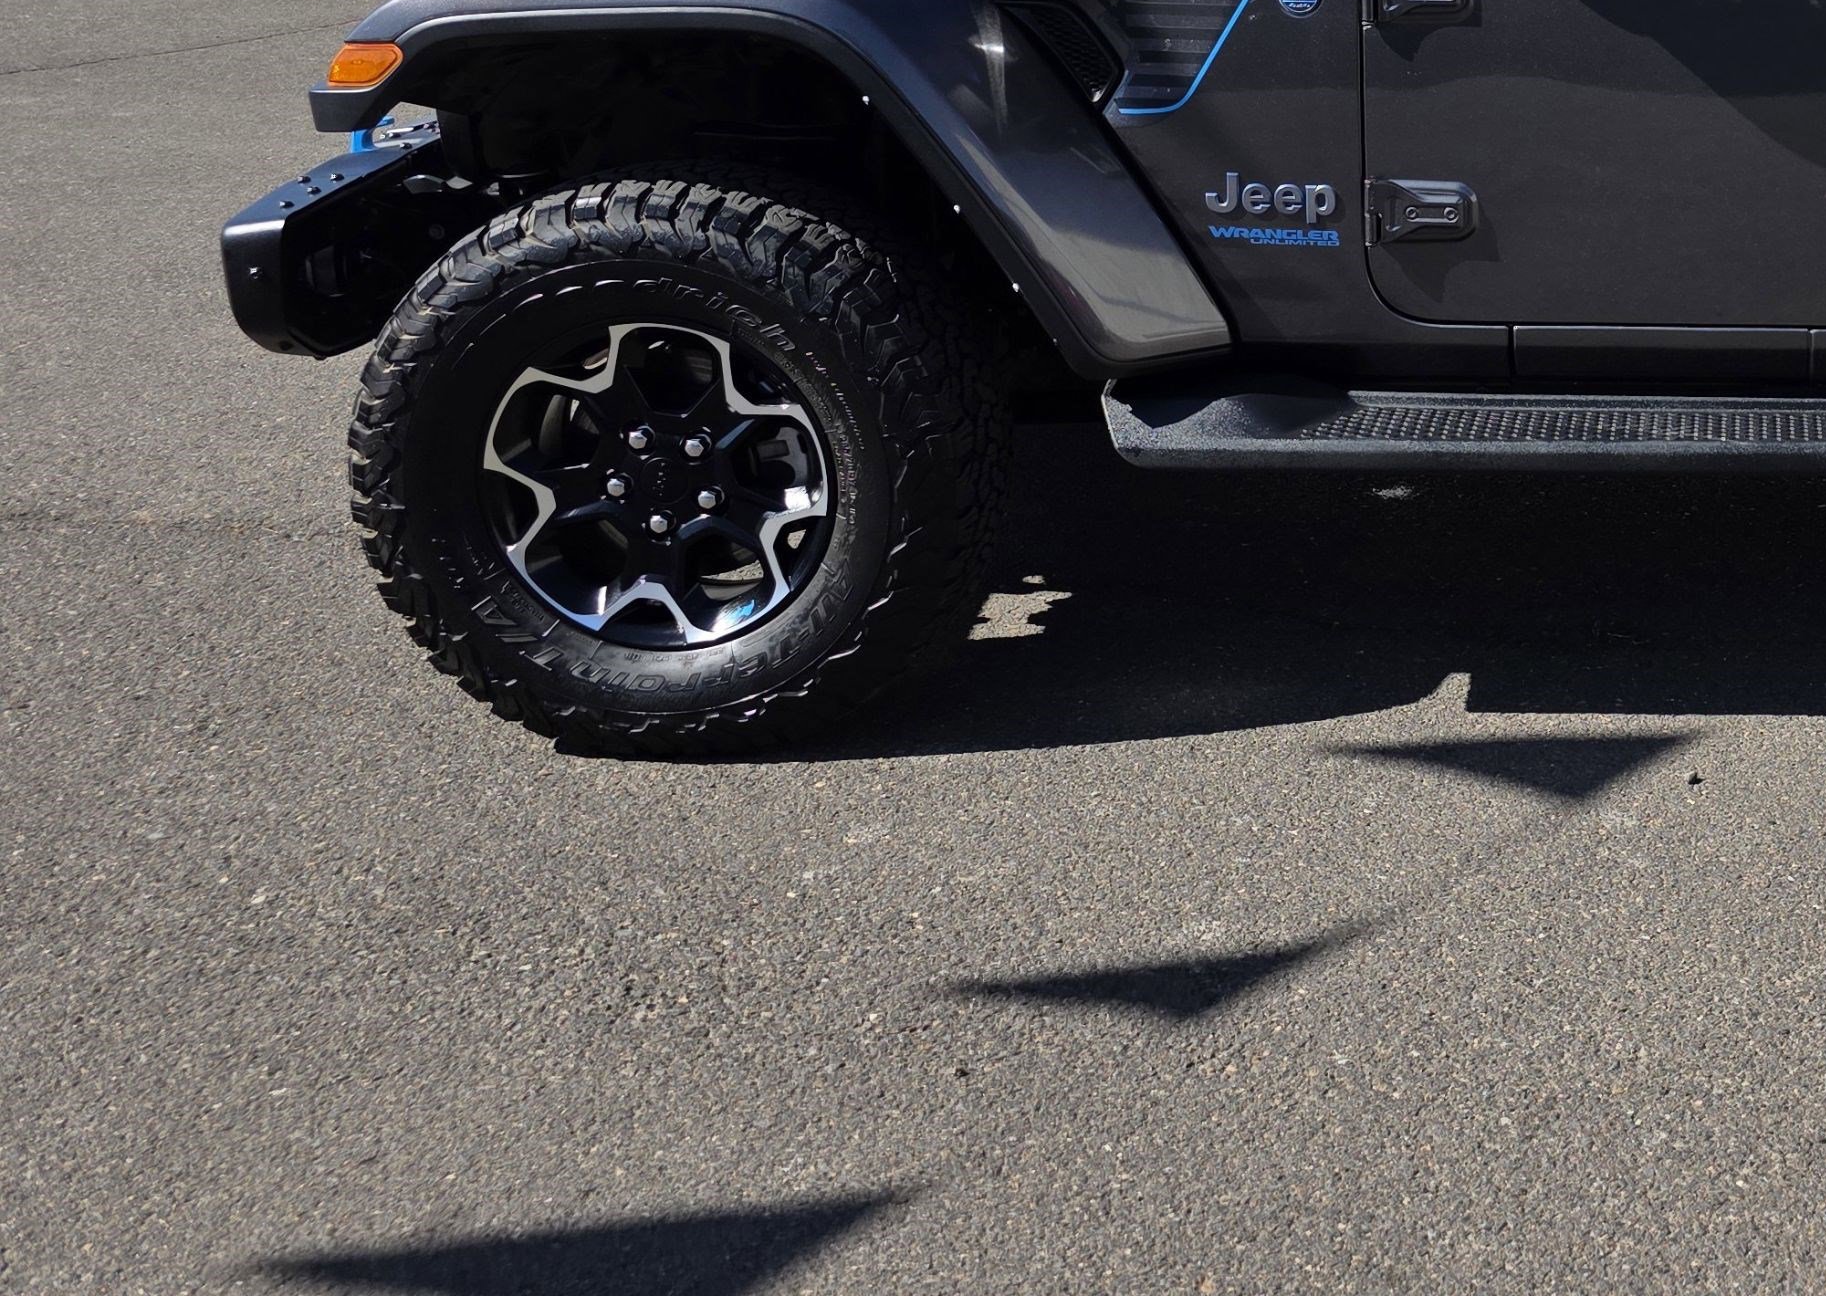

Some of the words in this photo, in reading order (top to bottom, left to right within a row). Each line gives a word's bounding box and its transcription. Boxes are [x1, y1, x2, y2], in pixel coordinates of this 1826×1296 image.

[1205, 172, 1337, 224] Jeep
[1208, 225, 1340, 240] WRANGLER
[1249, 238, 1341, 247] UNLIMITED
